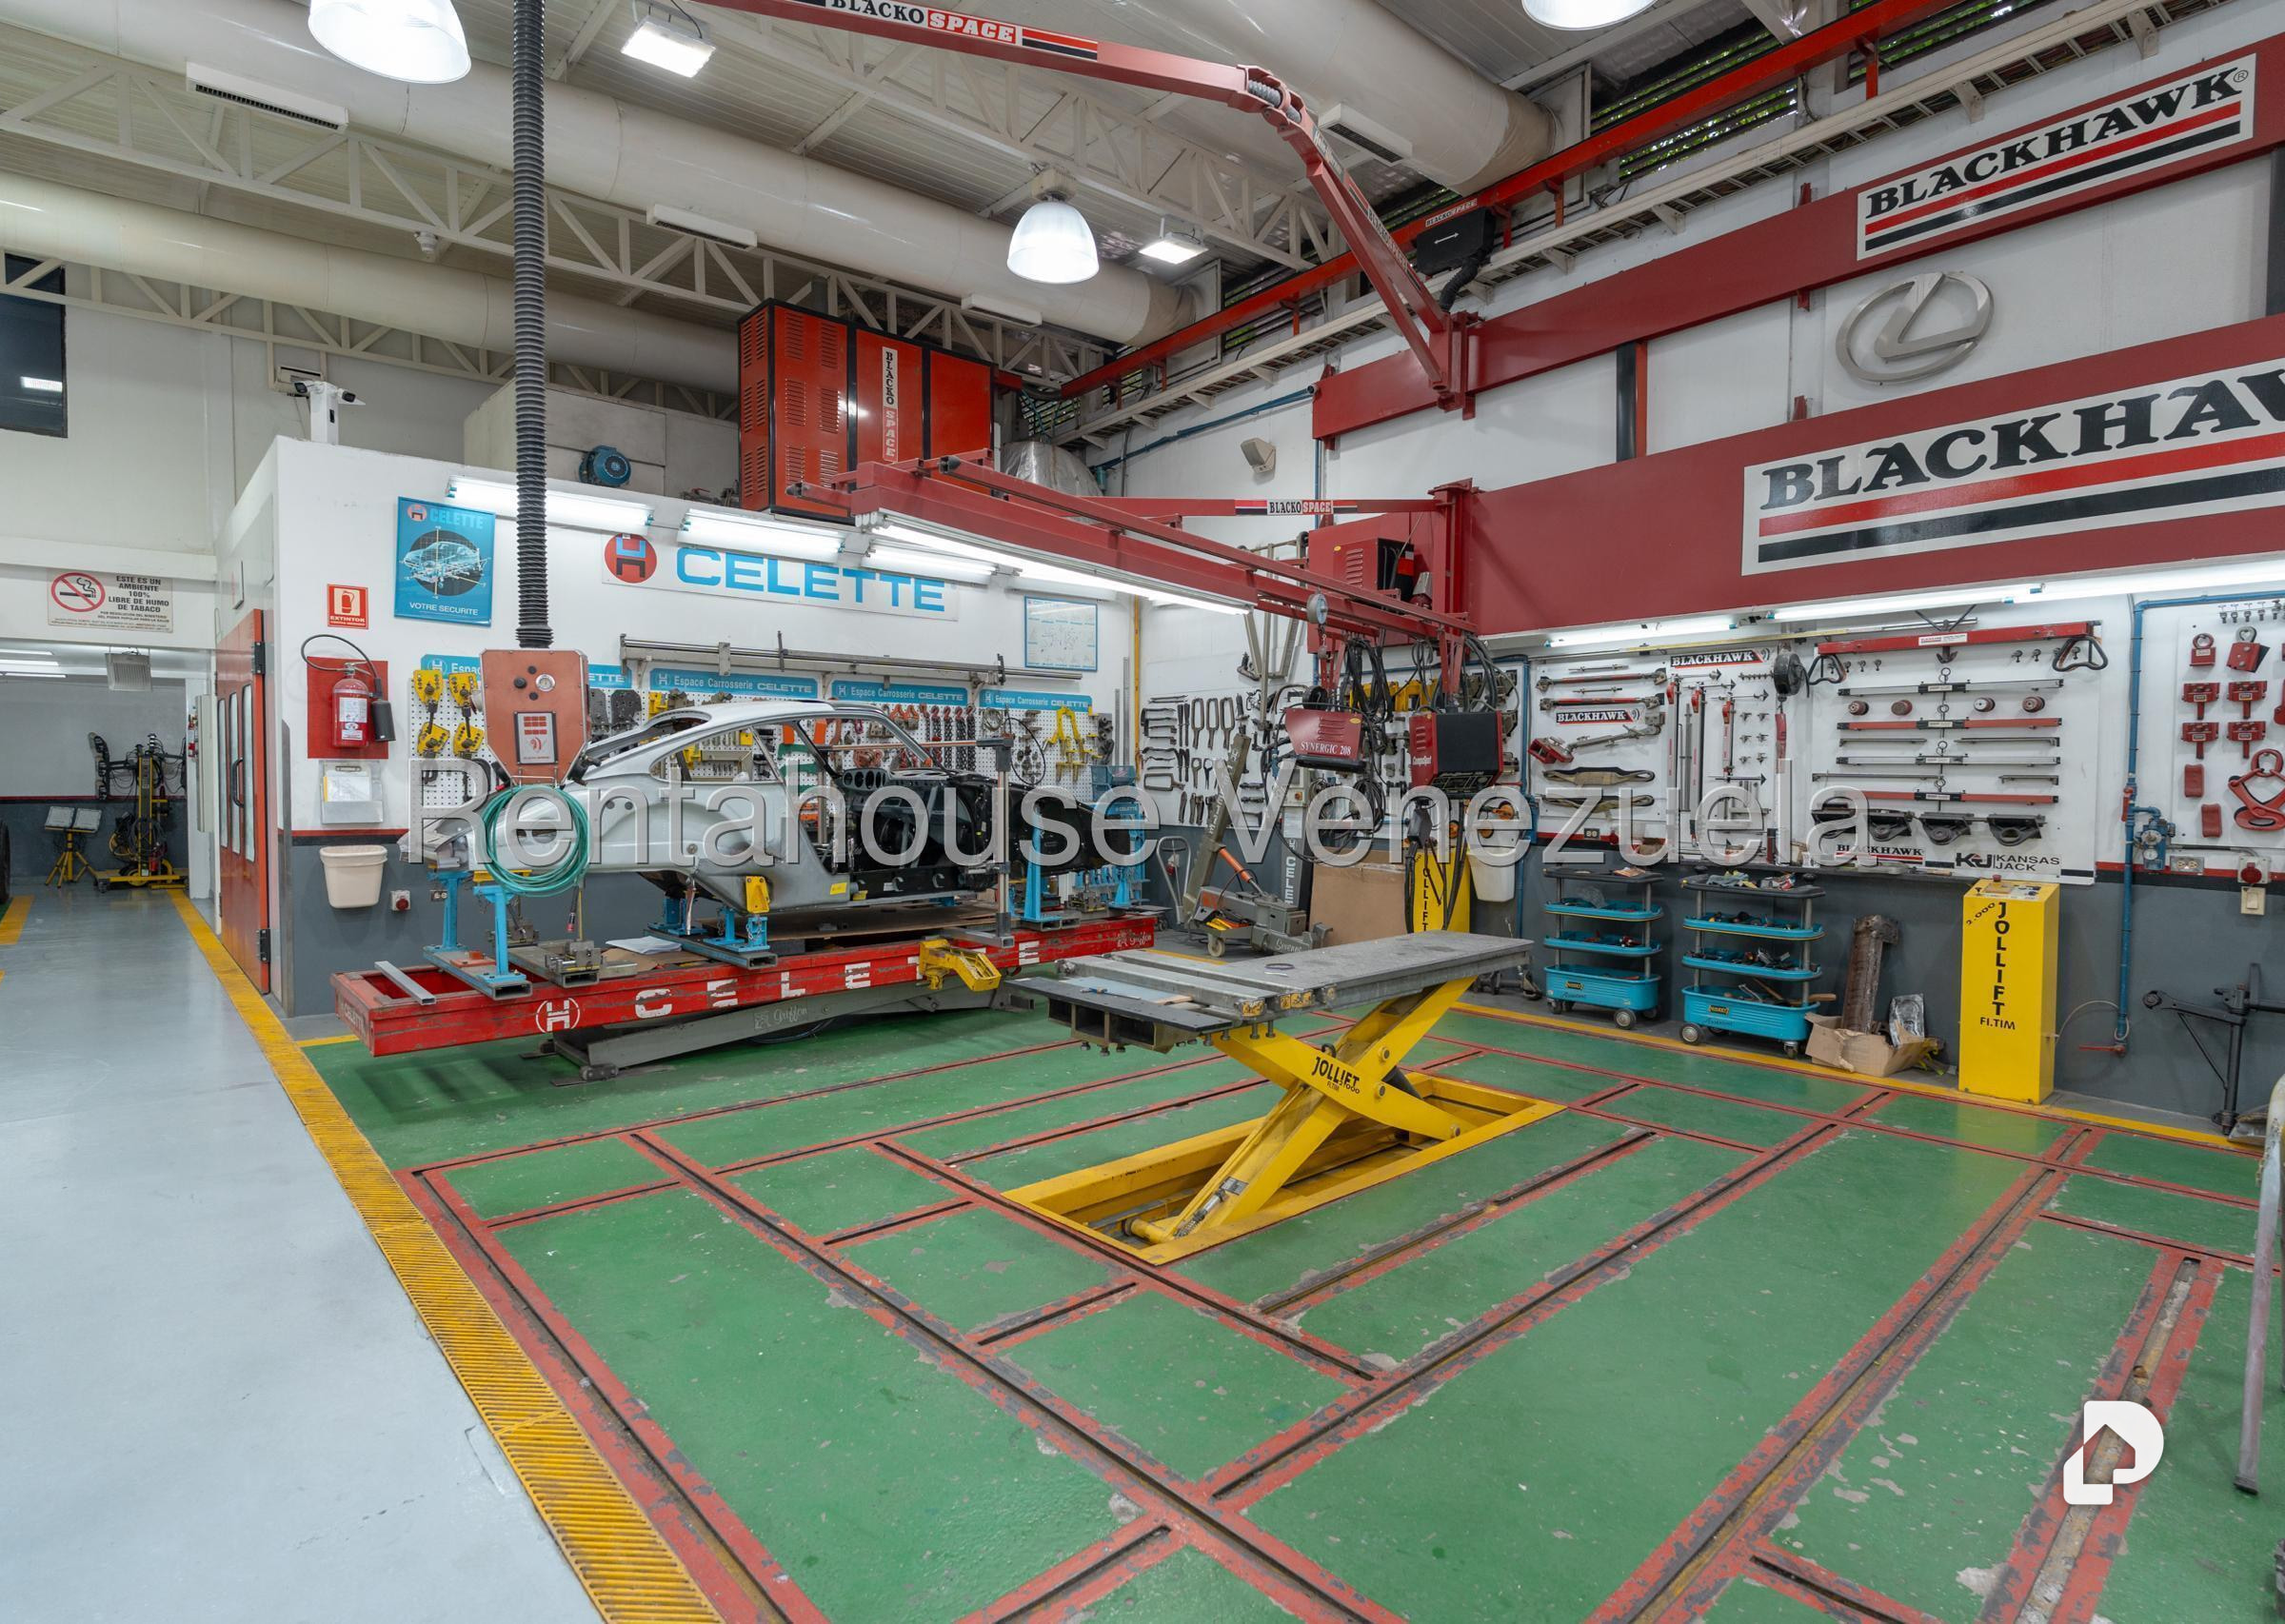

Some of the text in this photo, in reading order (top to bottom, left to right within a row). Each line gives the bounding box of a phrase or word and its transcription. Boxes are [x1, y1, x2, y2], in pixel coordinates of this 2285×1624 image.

[928, 12, 1014, 43] SPACE
[1866, 67, 2243, 219] BLACKHAWK
[885, 350, 894, 406] BLACKO
[885, 409, 896, 457] SPACE
[1269, 501, 1332, 514] BLACKO SPACE
[429, 507, 484, 529] CELETTE
[116, 575, 136, 584] ESTE
[677, 547, 944, 612] CELETTE
[118, 583, 159, 592] AMBIENTE
[108, 596, 131, 604] LIBRE
[130, 604, 161, 613] TABACO
[409, 602, 437, 611] VOTRE
[438, 604, 479, 616] SECURITE
[1672, 651, 1753, 666] BLACKHAWK
[588, 672, 625, 683] ETTE
[674, 676, 813, 693] Espace Carrosserie CELETTE
[850, 686, 964, 702] Espace Carrosserie CELETTE
[995, 695, 1015, 704] Espace
[1017, 696, 1048, 705] Carrosserie
[1557, 710, 1625, 723] BLACKHAWK
[1301, 742, 1352, 756] SYNERGIC 208
[1997, 854, 2060, 865] KANSAS
[1996, 862, 2036, 872] JACK
[1992, 901, 2010, 1016] JOLLIFT
[635, 941, 1041, 1020] CELEE
[1311, 1056, 1360, 1087] JOLLIFT
